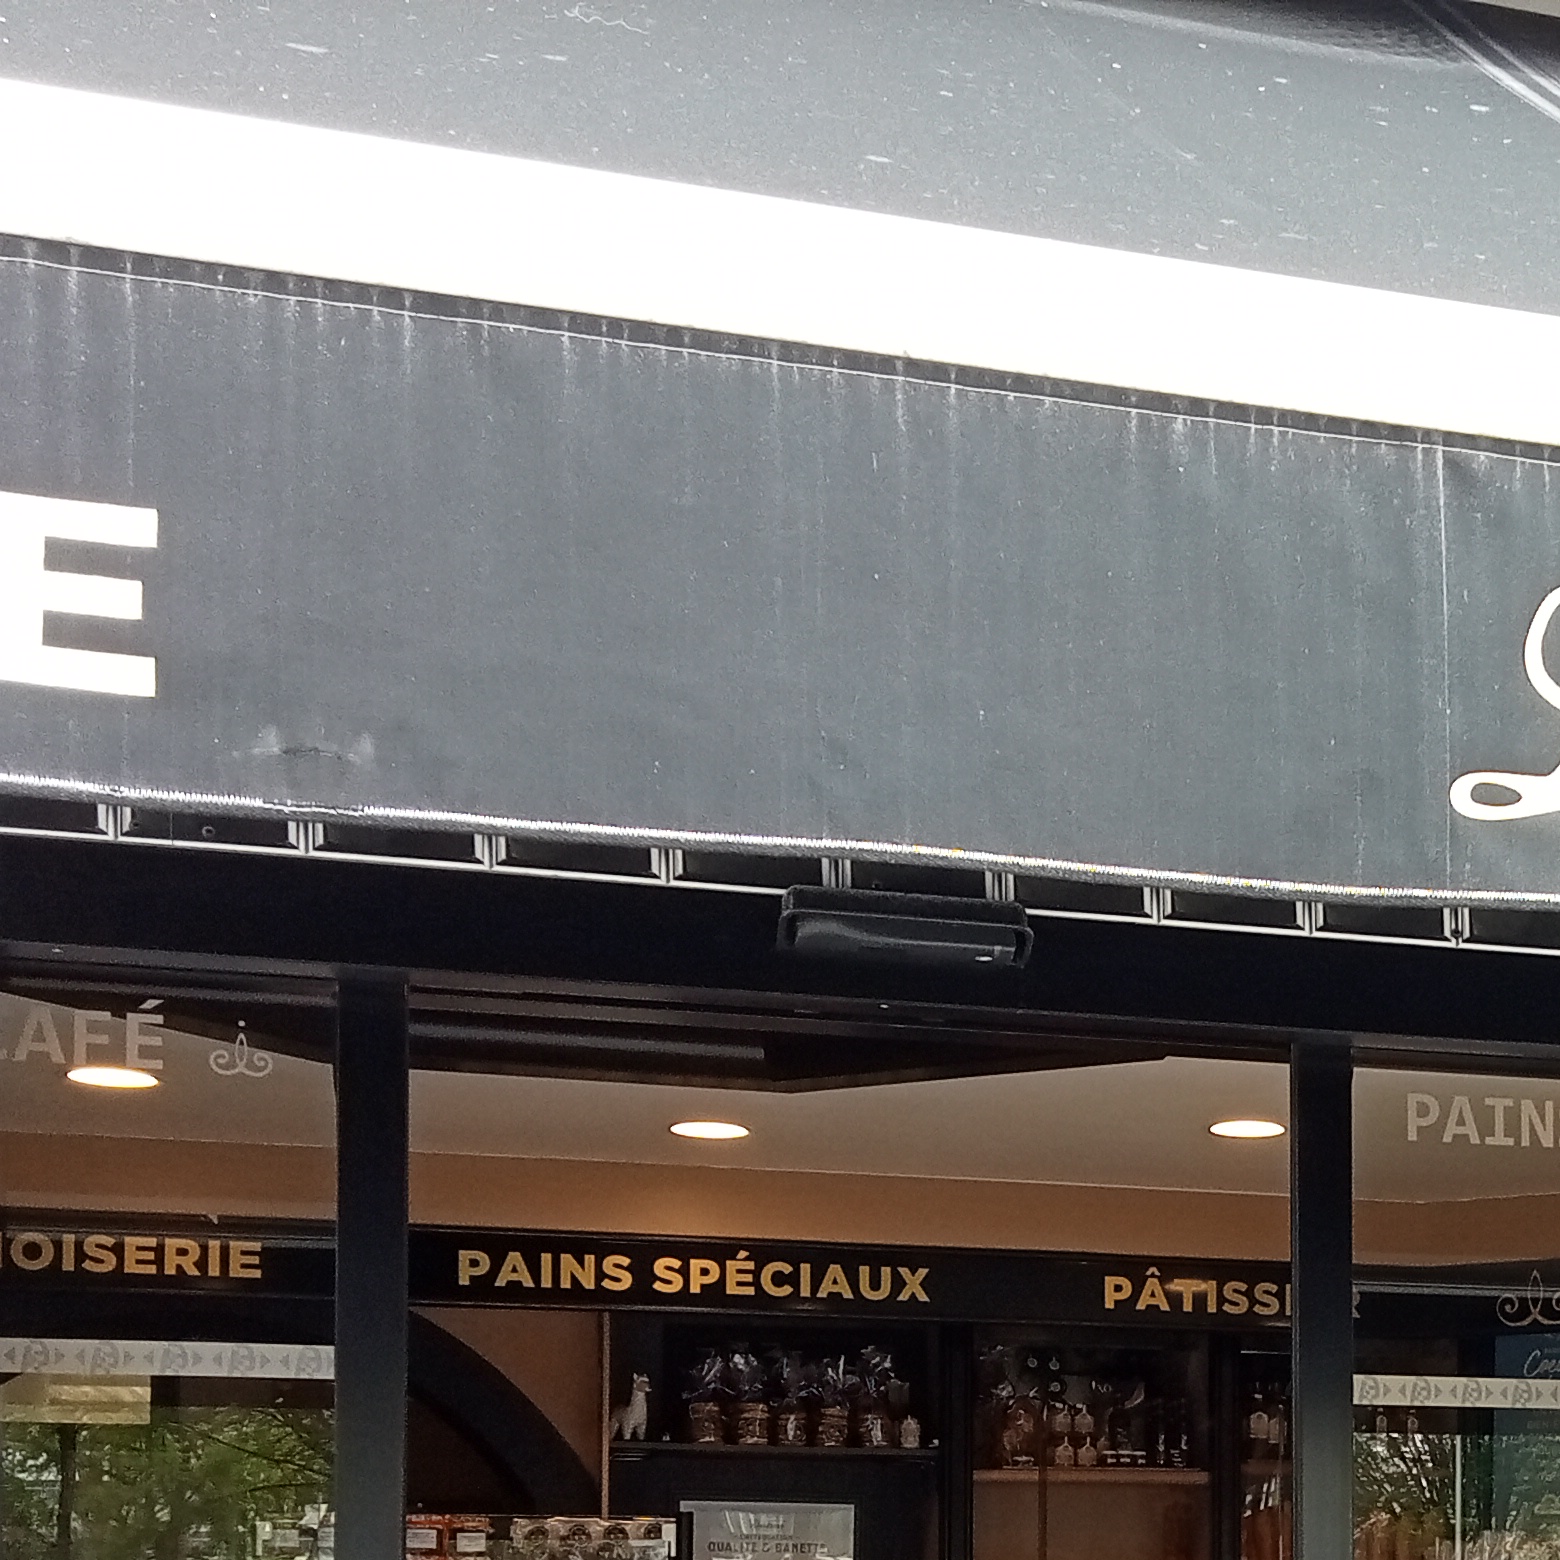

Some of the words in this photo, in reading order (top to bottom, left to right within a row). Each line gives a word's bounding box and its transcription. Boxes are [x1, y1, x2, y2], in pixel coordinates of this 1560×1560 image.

[0, 999, 164, 1070] AFÉ
[0, 1231, 262, 1279] OISERIE
[457, 1249, 633, 1292] PAINS
[652, 1250, 930, 1303] SPÉCIAUX
